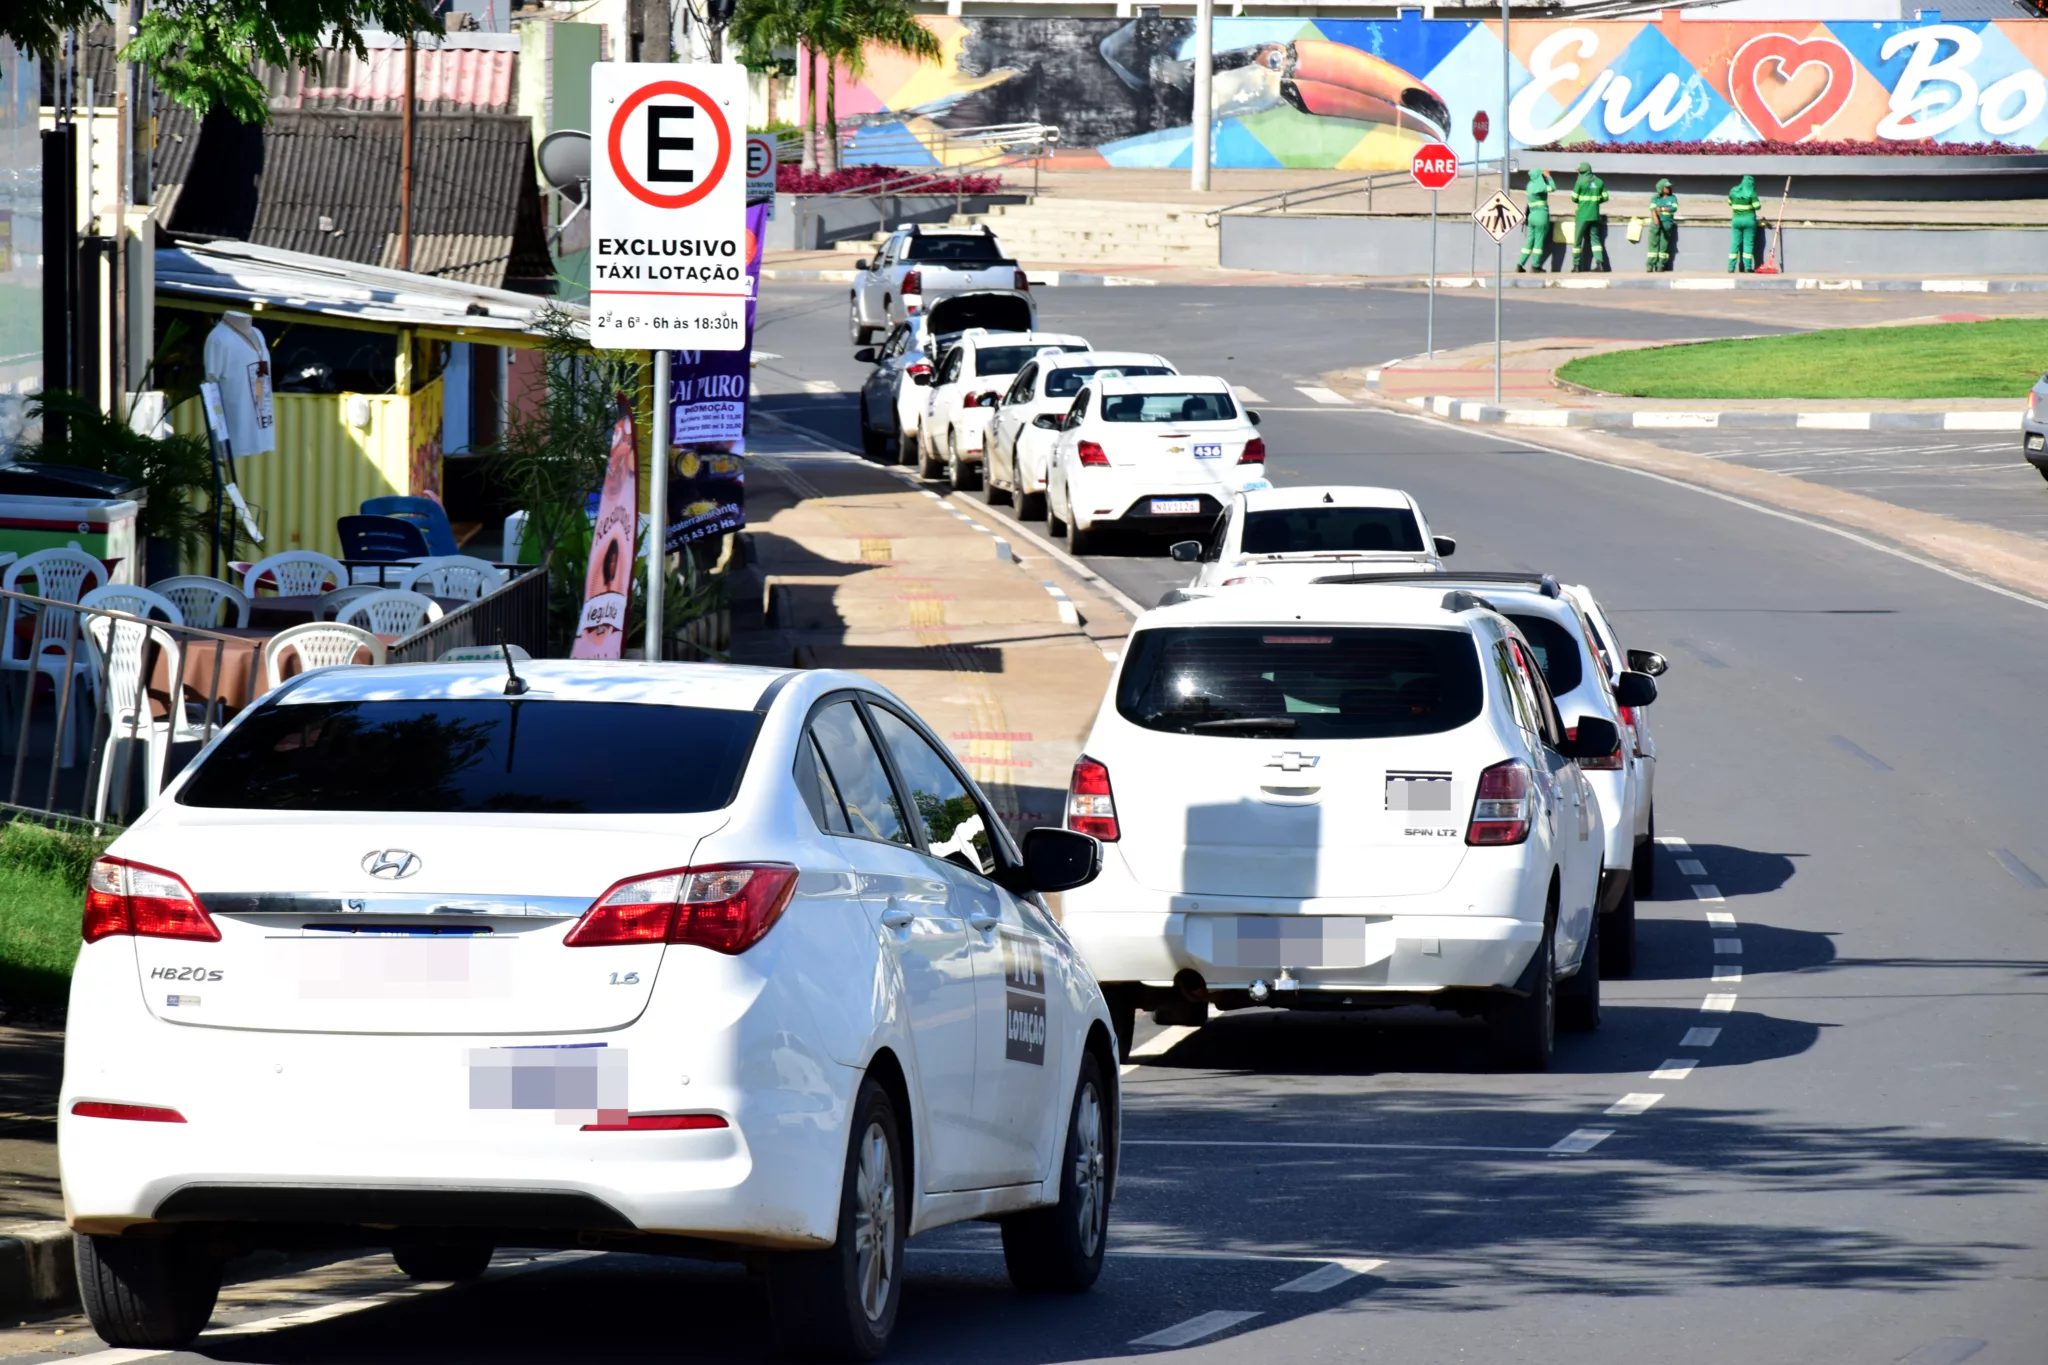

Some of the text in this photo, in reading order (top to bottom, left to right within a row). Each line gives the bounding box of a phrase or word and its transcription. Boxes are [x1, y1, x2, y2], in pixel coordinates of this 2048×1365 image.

[647, 105, 694, 182] E
[1414, 159, 1455, 173] PARE
[598, 238, 737, 257] EXCLUSIVO
[596, 262, 641, 279] TÁXI
[648, 263, 739, 284] LOTAÇÃO
[615, 318, 623, 328] a
[627, 316, 640, 328] 6ª
[653, 316, 669, 329] 6h
[673, 316, 689, 329] às
[694, 317, 738, 330] 18:30h
[1195, 446, 1221, 456] 436
[706, 524, 718, 534] 22
[720, 519, 736, 529] Hs
[1404, 828, 1457, 837] SPIN LTZ
[608, 971, 641, 985] 1.6
[1008, 1005, 1046, 1052] LOTAÇÃO
